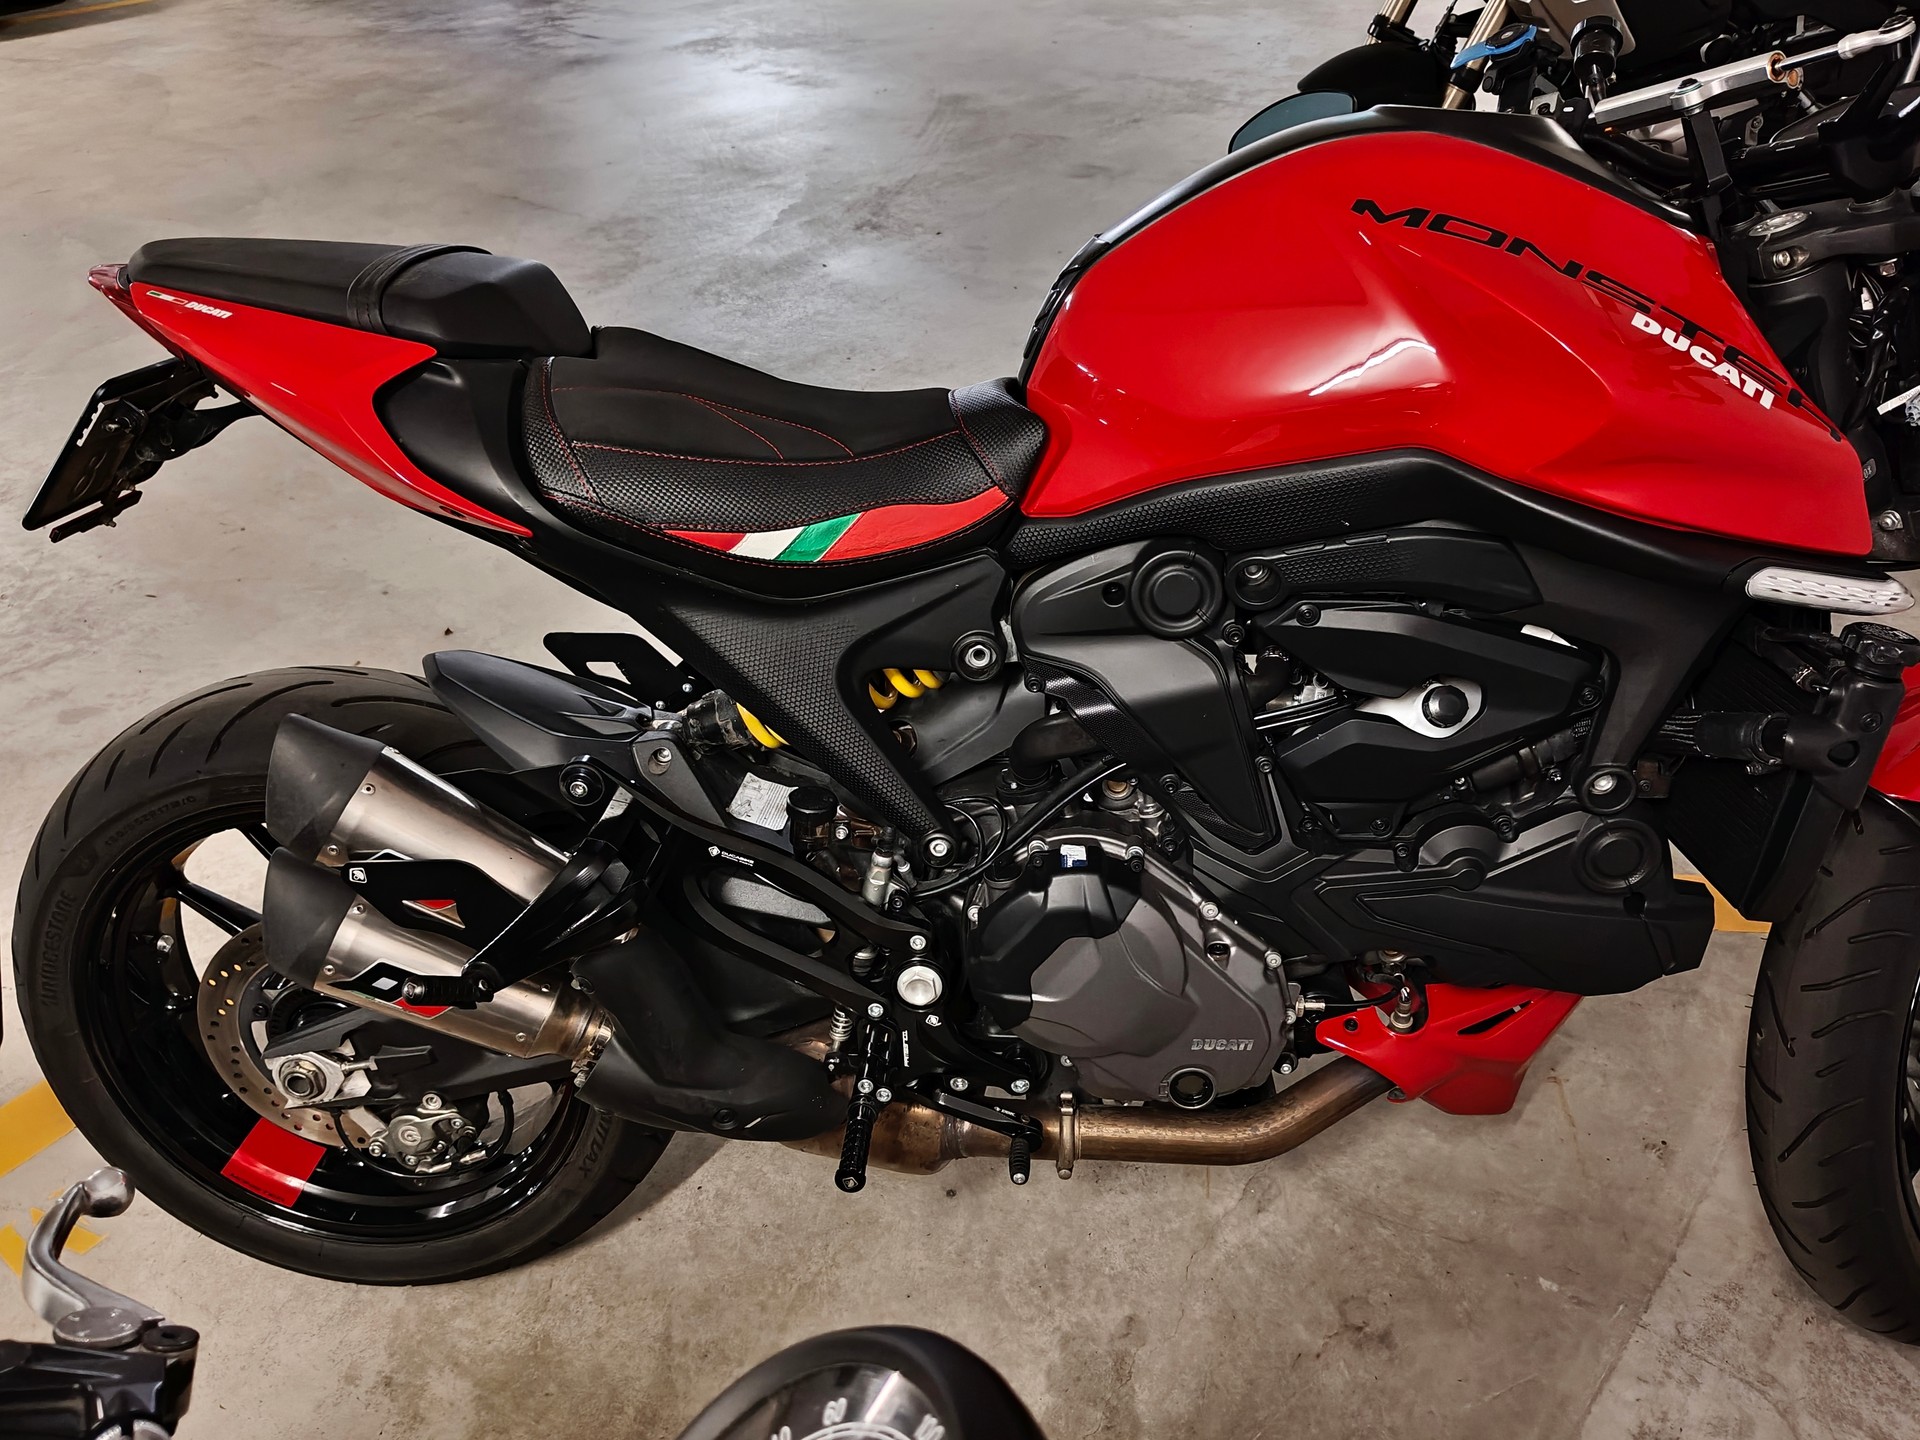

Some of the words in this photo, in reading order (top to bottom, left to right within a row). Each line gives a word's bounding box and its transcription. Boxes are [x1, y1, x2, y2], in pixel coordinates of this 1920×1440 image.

[184, 301, 233, 319] DUCATI
[1630, 311, 1776, 410] DUCATI
[41, 889, 78, 1007] BRIDGESTONE
[1190, 1038, 1255, 1051] DUCATI
[822, 1397, 848, 1427] 60
